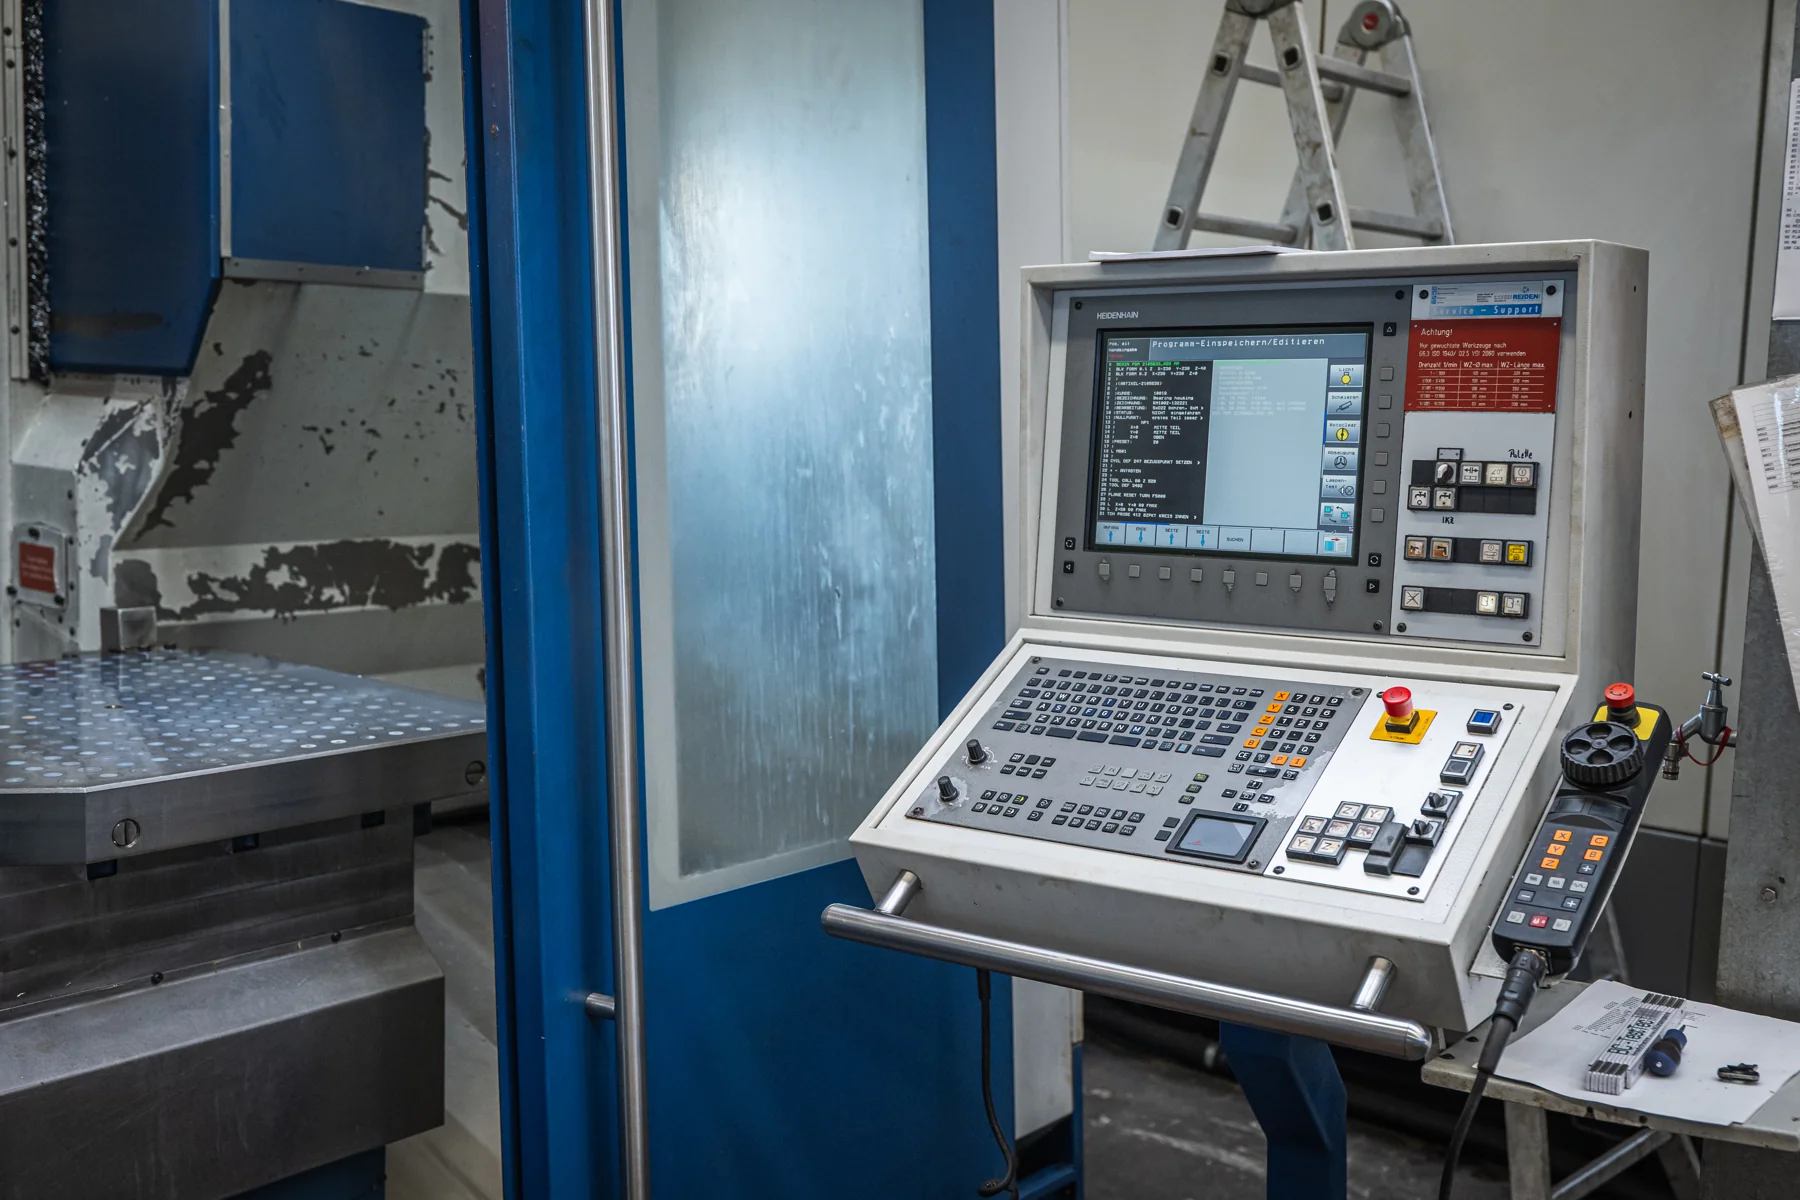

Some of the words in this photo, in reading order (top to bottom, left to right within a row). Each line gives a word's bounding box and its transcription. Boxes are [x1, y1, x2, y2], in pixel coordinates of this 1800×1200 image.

[1494, 306, 1538, 315] Support
[1421, 328, 1453, 337] Achtung!
[1152, 338, 1325, 348] Programm-Einspeichern/Editieren
[1508, 449, 1533, 459] Palette
